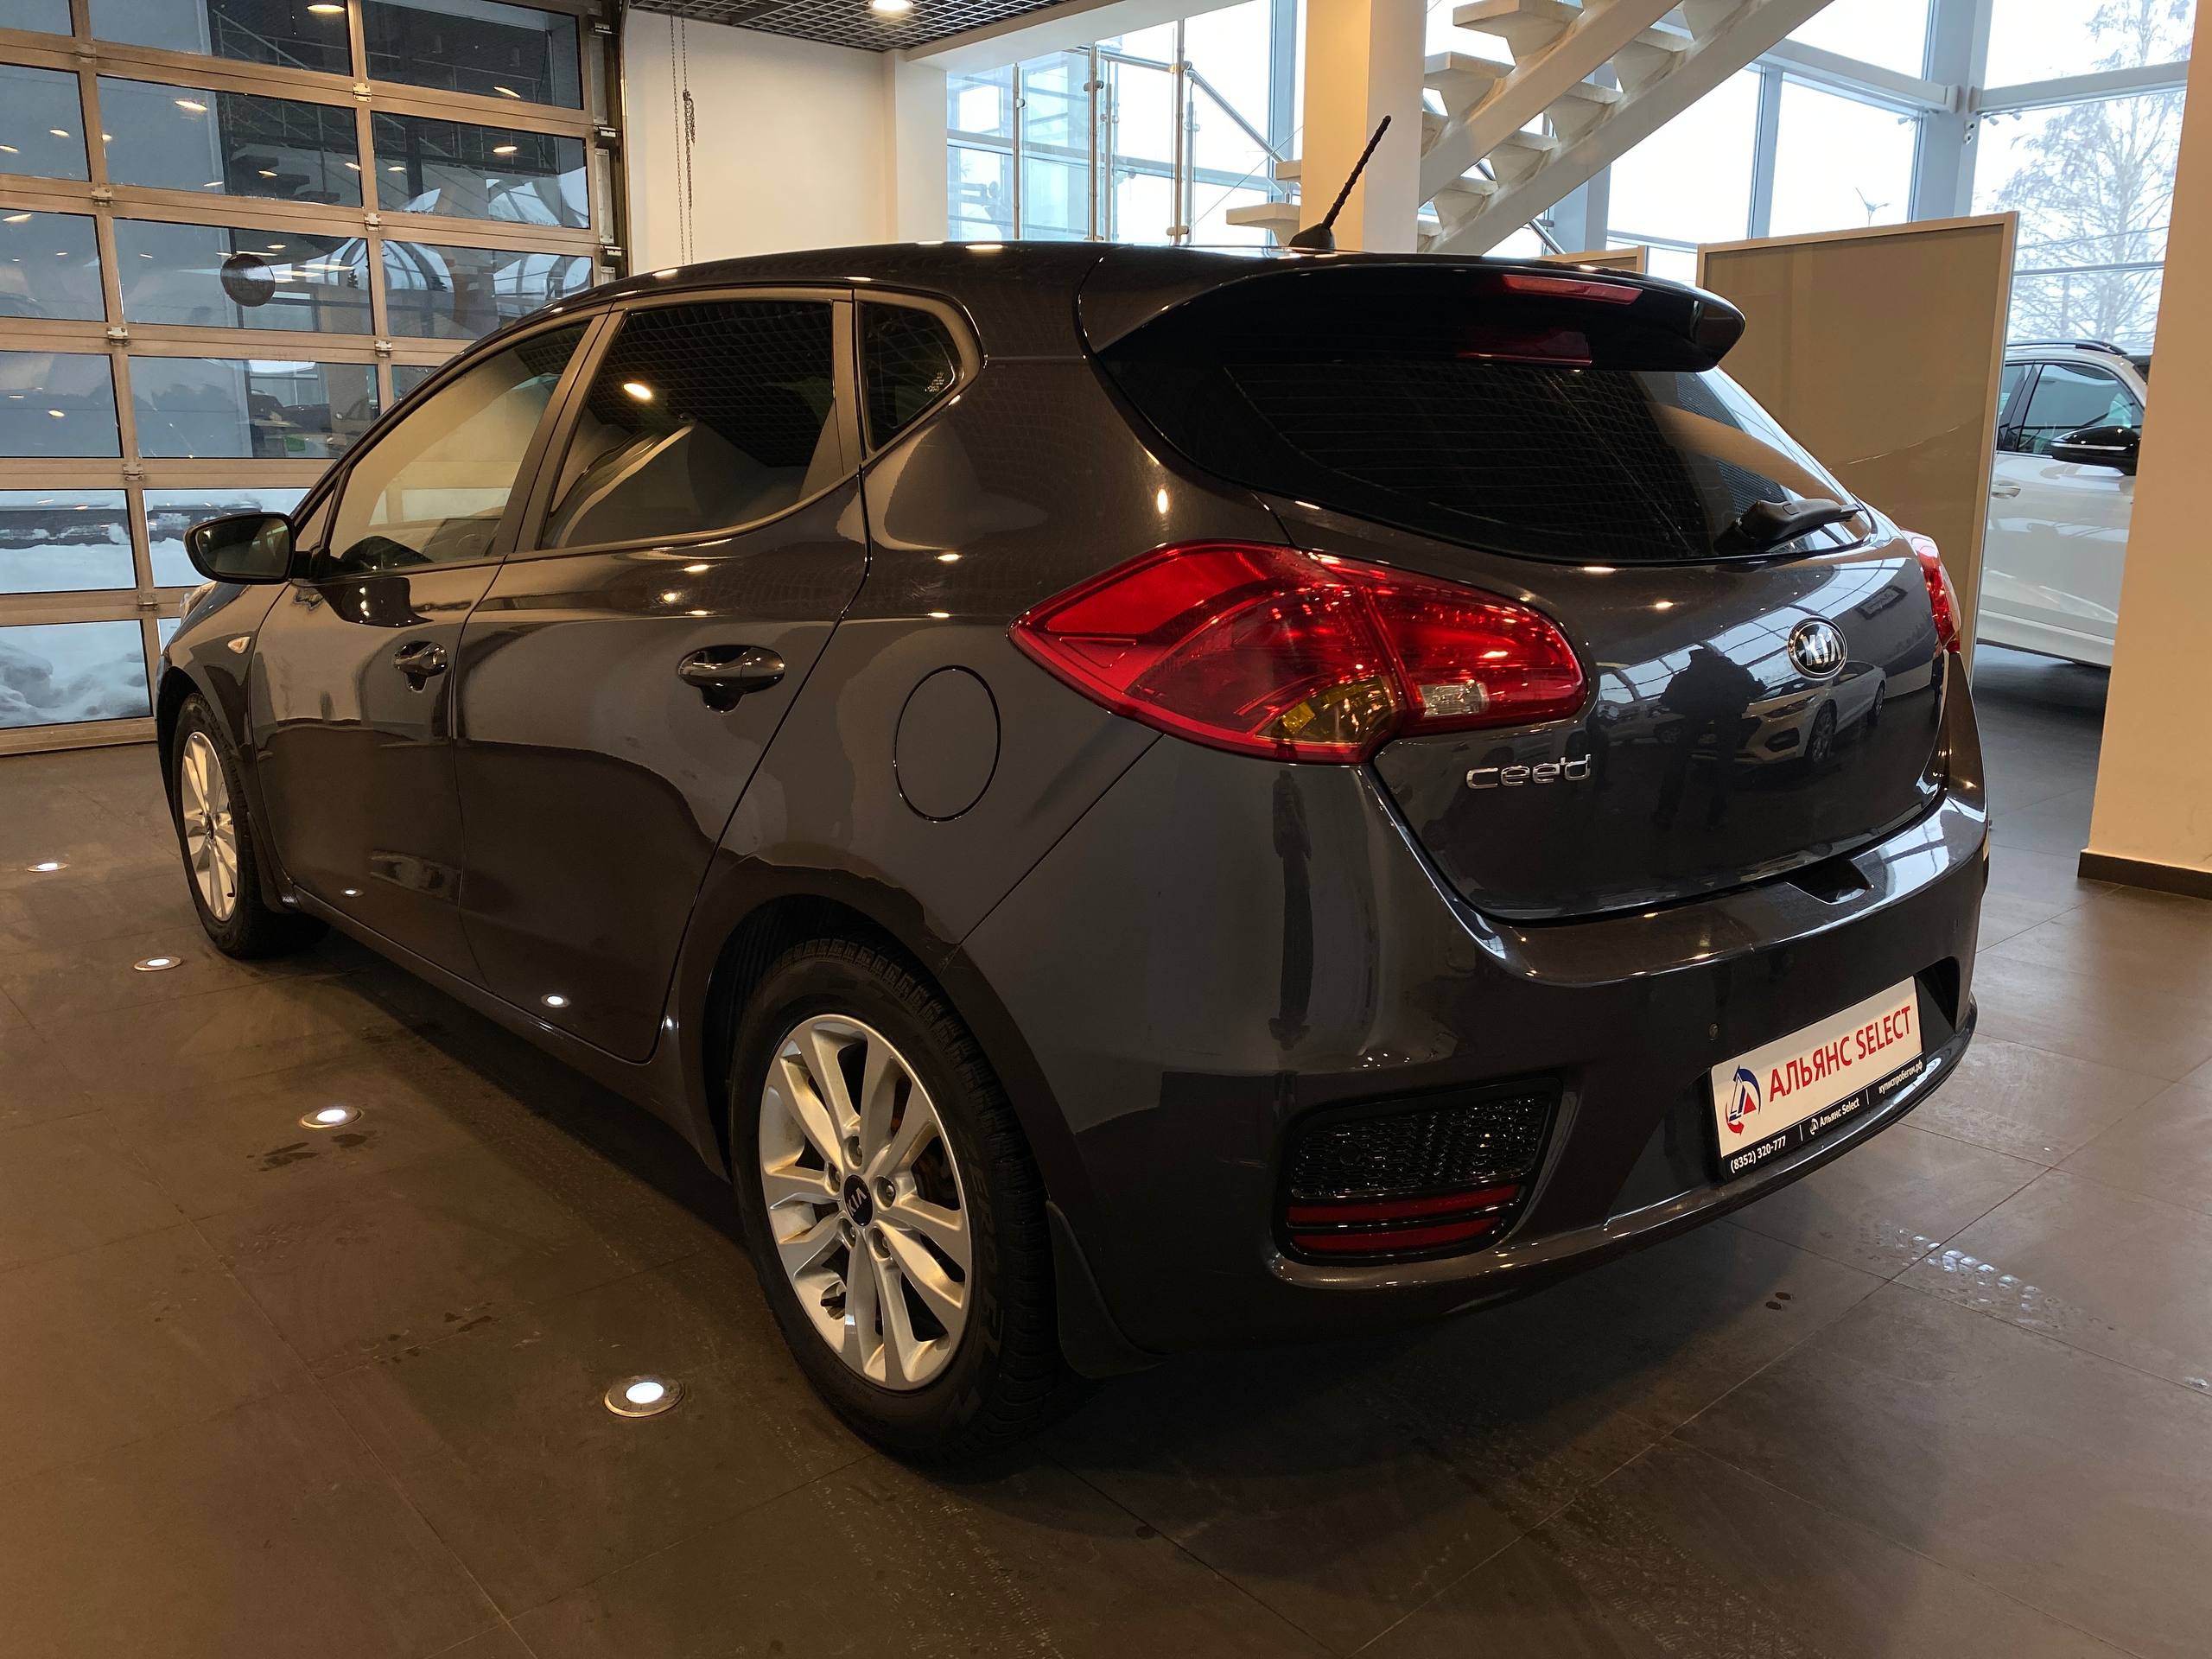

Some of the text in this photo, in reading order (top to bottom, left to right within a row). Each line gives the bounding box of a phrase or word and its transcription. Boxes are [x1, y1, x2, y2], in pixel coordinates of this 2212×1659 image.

[1800, 633, 1842, 666] KIA
[1769, 1006, 1910, 1103] АЛЬЯНС SELECT
[1819, 1097, 1860, 1128] Альянс Select
[1730, 1135, 1787, 1173] (8352) 320-777
[846, 1187, 868, 1217] KIA
